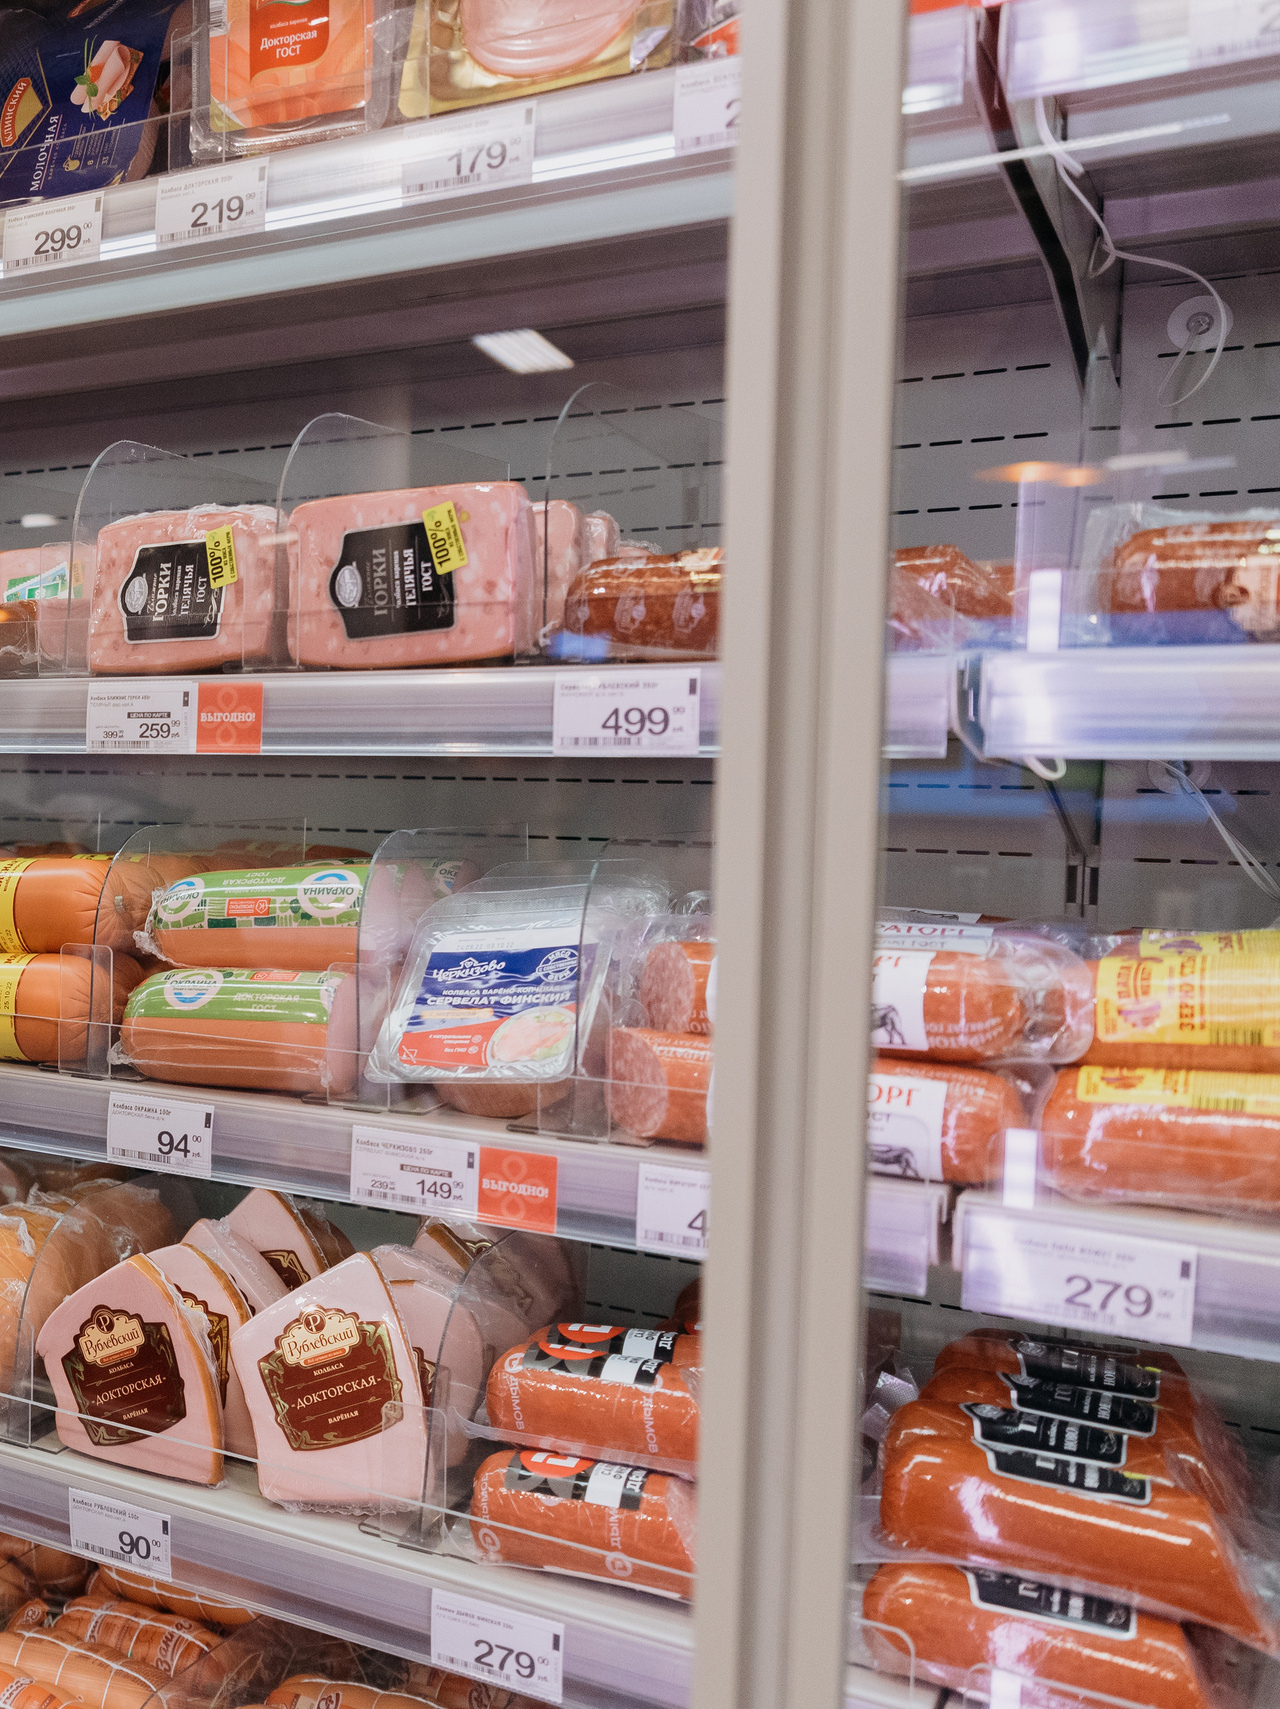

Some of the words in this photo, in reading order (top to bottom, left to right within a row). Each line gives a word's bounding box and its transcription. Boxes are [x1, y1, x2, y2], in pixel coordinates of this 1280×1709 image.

[260, 28, 317, 51] Докторская
[276, 44, 301, 59] ГОСТ
[5, 82, 27, 143] КЛИНСКИЙ
[30, 115, 60, 191] МОЛОЧНАЯ
[447, 141, 507, 177] 179
[161, 186, 182, 195] Колбаса
[183, 178, 219, 191] ДОКТОРСКАЯ
[190, 195, 244, 228] 219
[34, 224, 82, 255] 299
[428, 520, 451, 568] 100%
[208, 540, 224, 583] 100%
[372, 548, 388, 616] ГОРКИ
[402, 548, 417, 608] ТЕЛЯЧЬЯ
[420, 561, 433, 592] ГОСТ
[152, 562, 172, 622] ГОРКИ
[179, 564, 194, 617] ТЕЛЯЧЬЯ
[196, 576, 207, 603] ГОСТ
[200, 711, 256, 722] ВЫГОДНО!
[601, 707, 670, 736] 499
[103, 730, 118, 738] 399
[139, 723, 171, 739] 259
[222, 876, 286, 886] ДОКТОРСКАЯ
[303, 887, 355, 896] ОКРАИНА
[548, 950, 571, 961] МЯСО
[433, 960, 506, 981] Черкизово
[547, 970, 571, 982] ФЕРМ
[233, 992, 300, 1003] ДОКТОРСКАЯ
[251, 1003, 277, 1012] ГОСТ
[427, 995, 496, 1005] СЕРВЕЛАТ
[501, 991, 571, 1005] ФИНСКИЙ
[111, 1110, 143, 1118] ДОКТОРСКАЯ
[113, 1103, 133, 1111] Колбаса
[134, 1105, 158, 1114] ОКРАИНА
[157, 1130, 190, 1158] 94
[192, 1135, 202, 1143] 00
[355, 1146, 384, 1155] СЕРВЕЛАТ
[356, 1139, 379, 1148] Колбаса
[381, 1142, 417, 1153] ЧЕРКИЗОВО
[403, 1165, 419, 1173] ЦЕНА
[430, 1168, 450, 1177] КАРТЕ
[371, 1179, 388, 1190] 239
[416, 1179, 452, 1200] 149
[452, 1180, 464, 1189] 99
[482, 1178, 549, 1198] ВЫГОДНО!
[1065, 1274, 1153, 1318] 279
[99, 1314, 111, 1332] Р
[307, 1314, 322, 1332] Р
[84, 1327, 141, 1359] Рублёвский
[287, 1327, 354, 1360] Рублёвский
[108, 1361, 134, 1375] КОЛБАСА
[313, 1362, 344, 1377] КОЛБАСА
[95, 1374, 163, 1406] ДОКТОРСКАЯ
[296, 1375, 378, 1411] ДОКТОРСКАЯ
[504, 1376, 524, 1430] ДЫМОВ
[122, 1407, 149, 1420] ВАРЁНАЯ
[328, 1410, 359, 1425] ВАРЁНАЯ
[642, 1396, 658, 1454] ДЫМОВ
[72, 1498, 93, 1508] Колбаса
[93, 1502, 127, 1518] РУБЛЕВСКИЙ
[72, 1504, 104, 1517] ДОКТОРСКАЯ
[118, 1530, 151, 1560] 90
[152, 1539, 161, 1548] 00
[474, 1639, 536, 1679] 279
